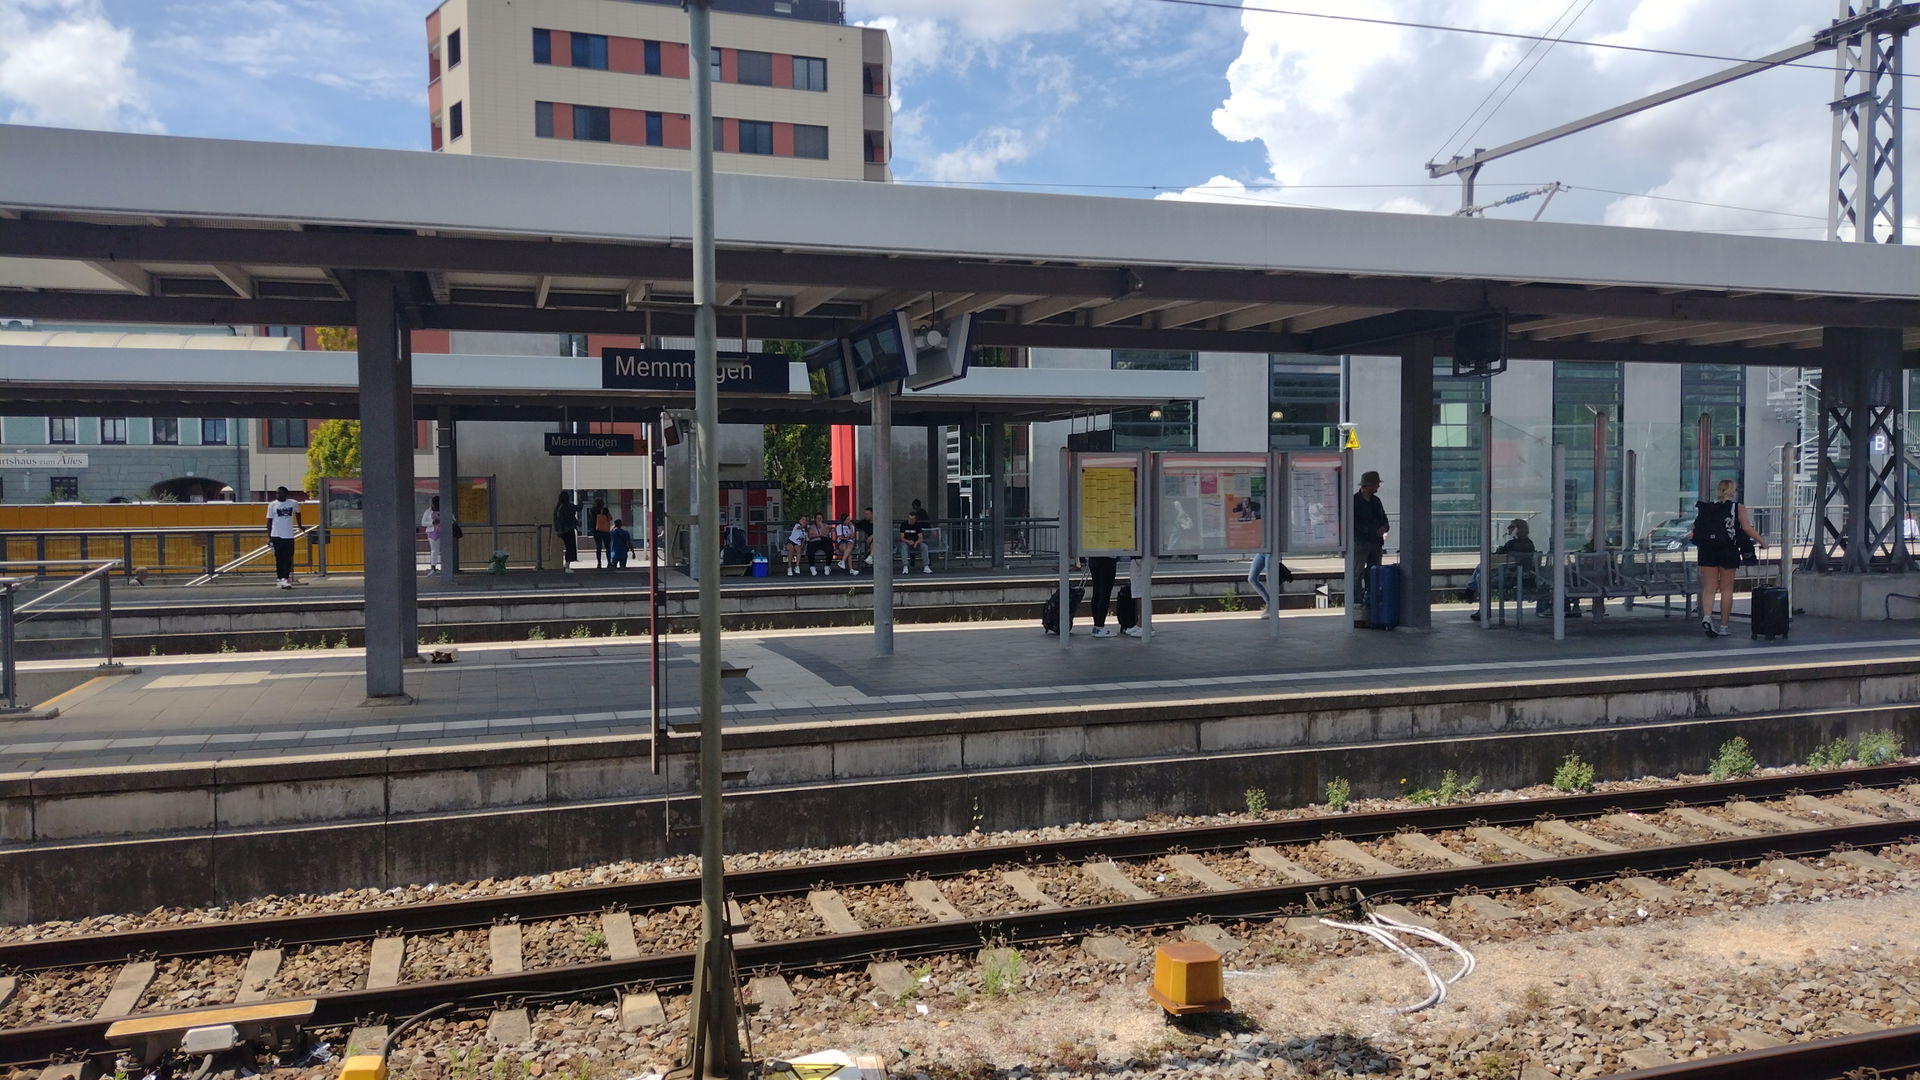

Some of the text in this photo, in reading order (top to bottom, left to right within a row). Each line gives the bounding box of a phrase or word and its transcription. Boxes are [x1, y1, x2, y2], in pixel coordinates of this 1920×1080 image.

[615, 355, 753, 384] Memmgen
[551, 436, 617, 449] Memmingen
[1875, 435, 1886, 451] B
